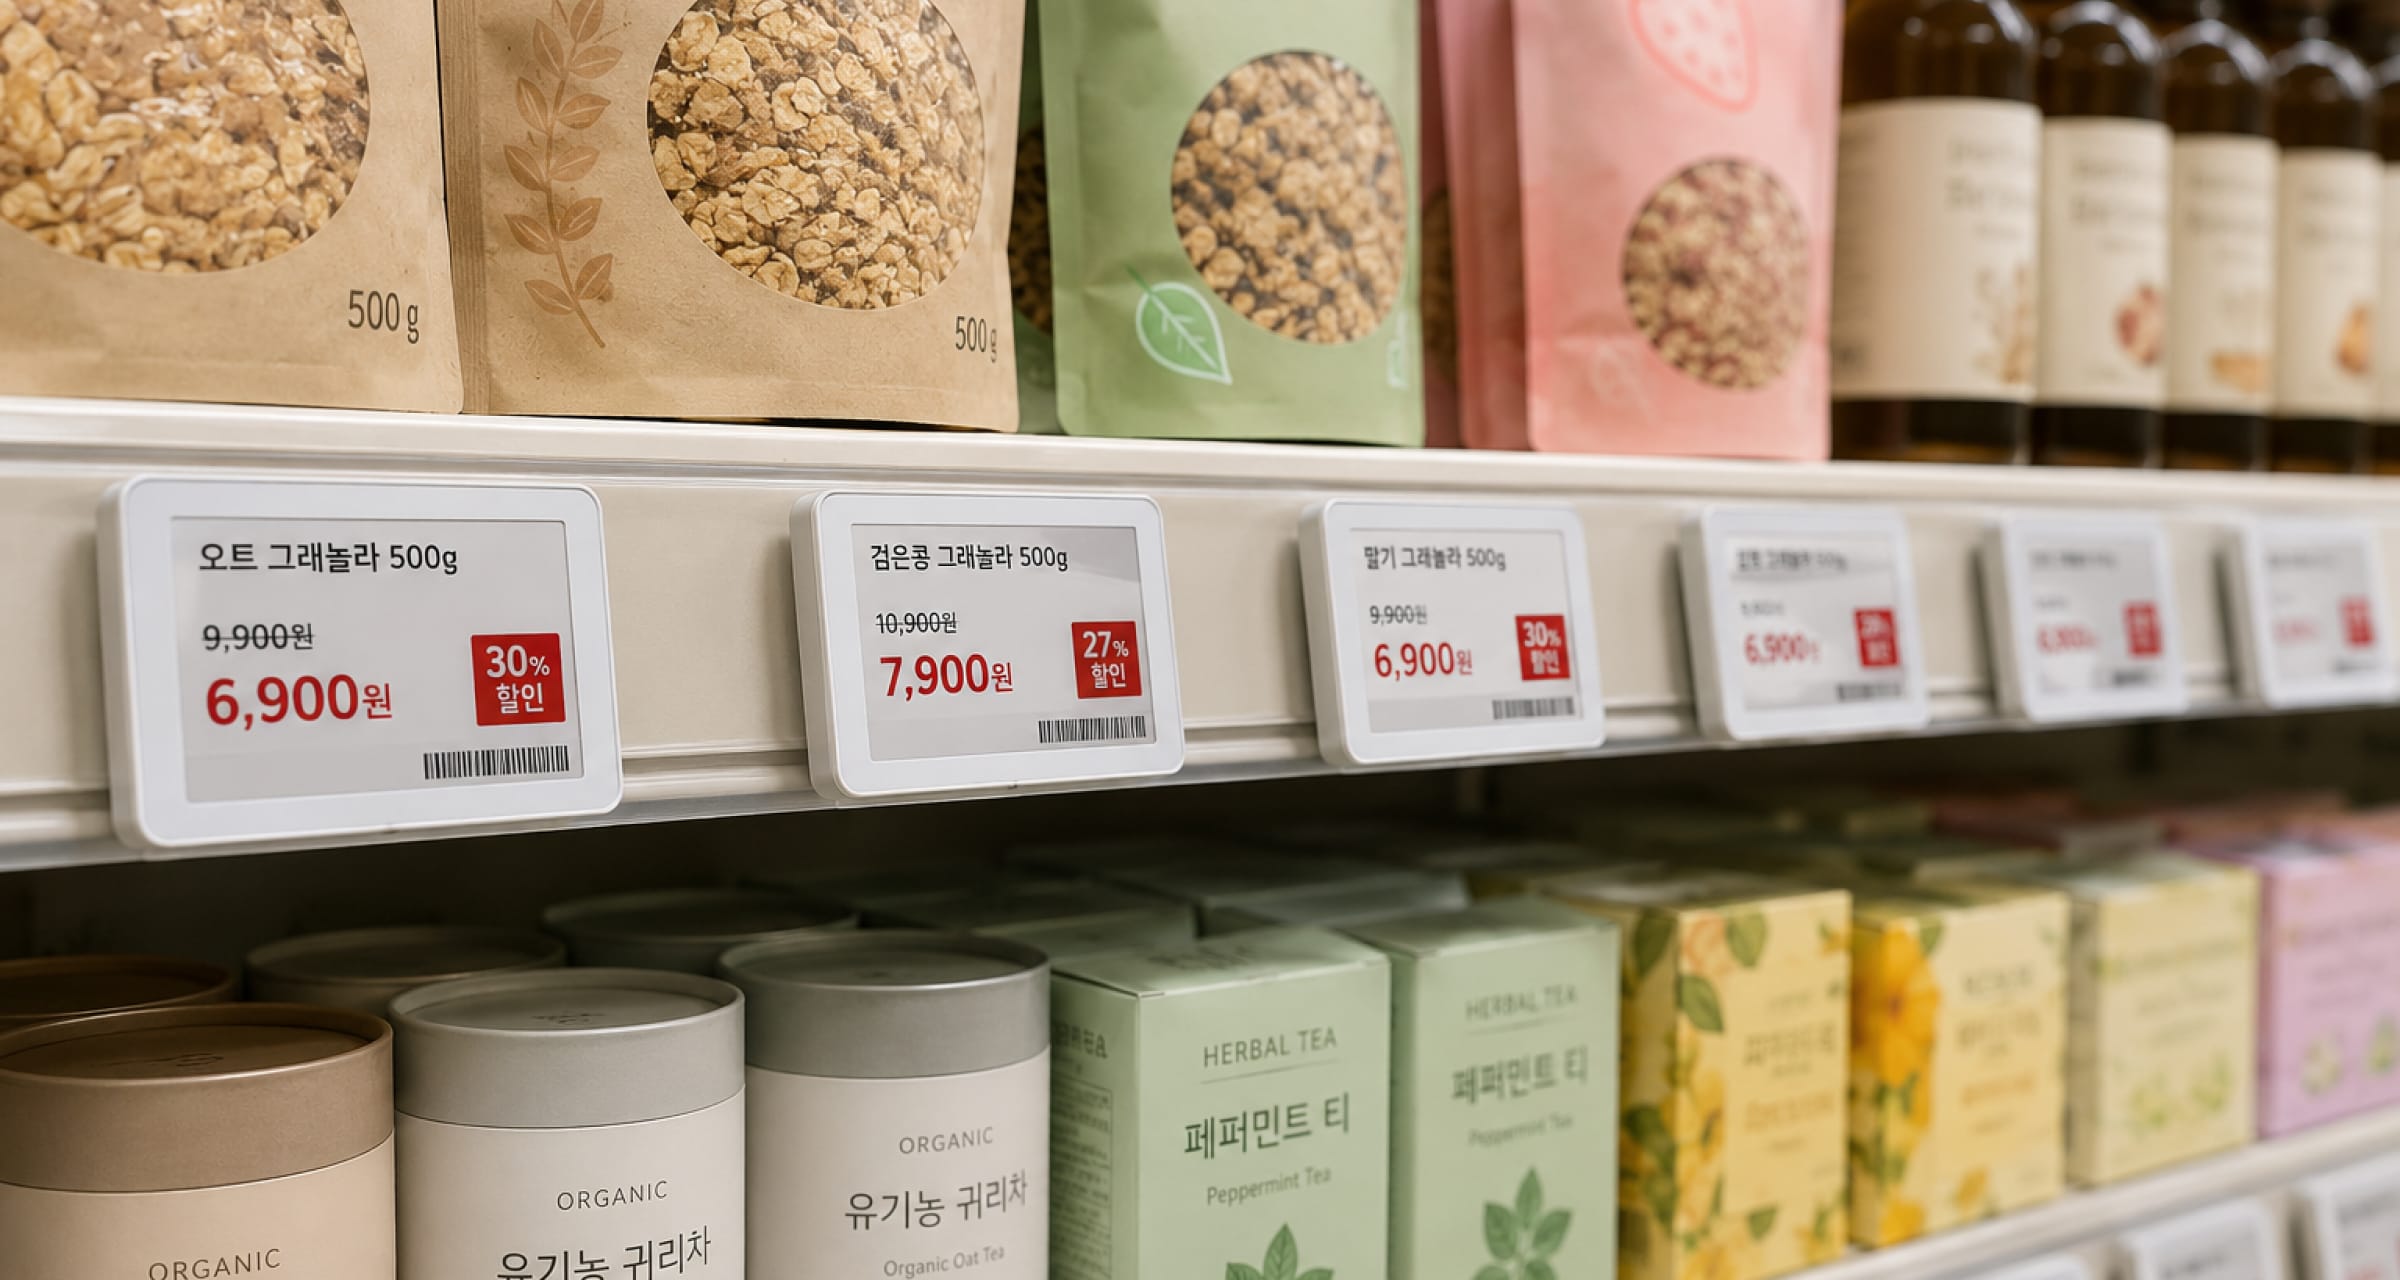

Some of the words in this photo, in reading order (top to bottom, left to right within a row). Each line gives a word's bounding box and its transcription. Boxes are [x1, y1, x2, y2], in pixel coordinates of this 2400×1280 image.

[347, 289, 400, 332] 500
[407, 304, 420, 345] g
[955, 315, 987, 353] 500
[990, 328, 997, 364] g
[199, 542, 259, 572] 오트
[267, 542, 380, 573] 그래놀라
[389, 544, 458, 575] 500g
[870, 543, 932, 572] 검은콩
[937, 544, 1013, 571] 그래놀라
[1019, 546, 1069, 571] 500g
[1400, 545, 1462, 570] 그래놀라
[1466, 547, 1506, 572] 500g
[874, 611, 958, 636] 10,900원
[1369, 604, 1428, 626] 9,900원
[201, 621, 314, 653] 9,900원
[1081, 630, 1129, 659] 27%
[1522, 620, 1562, 648] 30%
[485, 643, 551, 678] 30%
[878, 652, 1014, 702] 7,900원
[1090, 661, 1128, 690] 할인
[1374, 642, 1473, 682] 6,900원
[205, 673, 393, 731] 6,900원
[495, 682, 546, 715] 할인
[1203, 1033, 1291, 1068] HERBAL
[1297, 1025, 1338, 1053] TEA
[1452, 1052, 1558, 1105] 페퍼민트
[1564, 1043, 1589, 1085] 티
[899, 1126, 994, 1155] ORGANIC
[1184, 1102, 1313, 1160] 페퍼민트
[1323, 1091, 1350, 1134] 티
[556, 1179, 669, 1211] ORGANIC
[844, 1190, 946, 1231] 유기농
[956, 1167, 1028, 1222] 귀리차
[1207, 1172, 1301, 1207] Peppermint
[1304, 1165, 1332, 1185] Tea
[148, 1247, 282, 1280] ORGANIC
[622, 1224, 713, 1280] 귀리차
[883, 1255, 950, 1280] Organic
[952, 1250, 980, 1270] Oat
